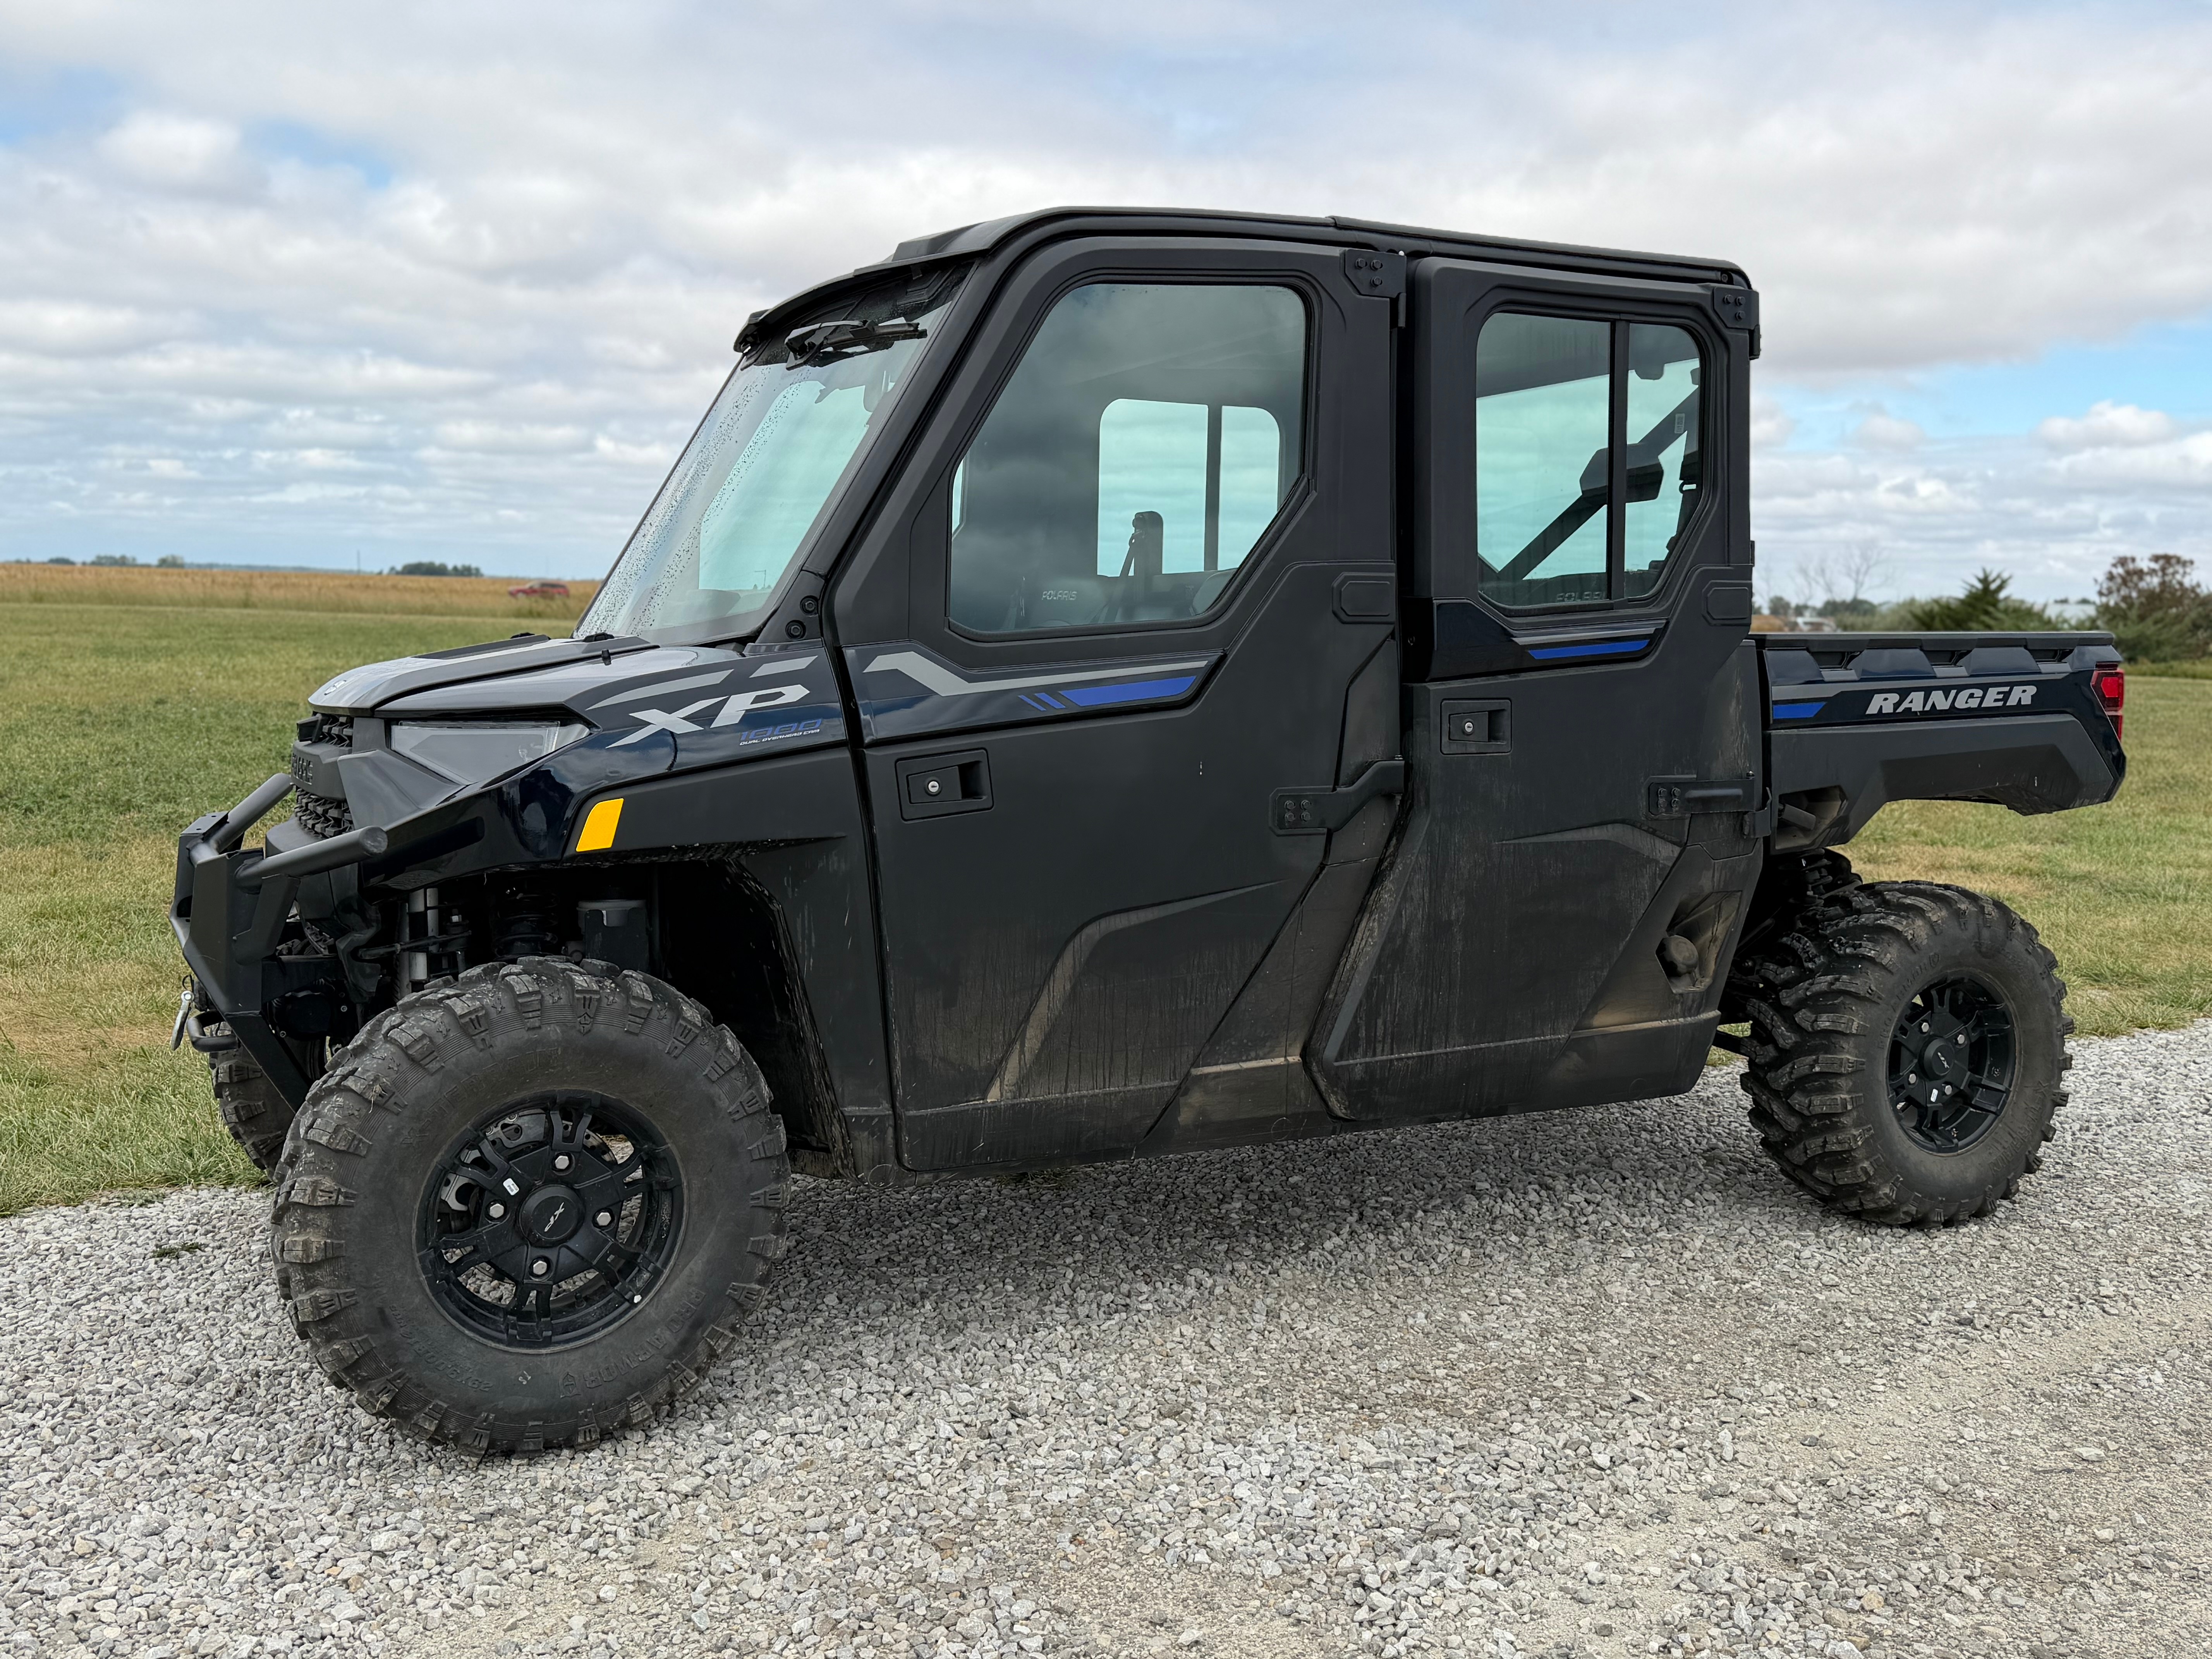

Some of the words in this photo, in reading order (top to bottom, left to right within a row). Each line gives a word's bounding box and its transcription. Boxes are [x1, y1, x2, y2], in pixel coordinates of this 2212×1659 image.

[1041, 590, 1077, 601] POLARIS
[1556, 591, 1607, 603] POLARI
[1866, 685, 2037, 715] RANGER
[605, 684, 810, 748] XP
[740, 719, 822, 740] 1000
[762, 732, 802, 742] OVERHEAD
[1938, 1052, 1950, 1068] XP
[544, 1202, 565, 1232] XP
